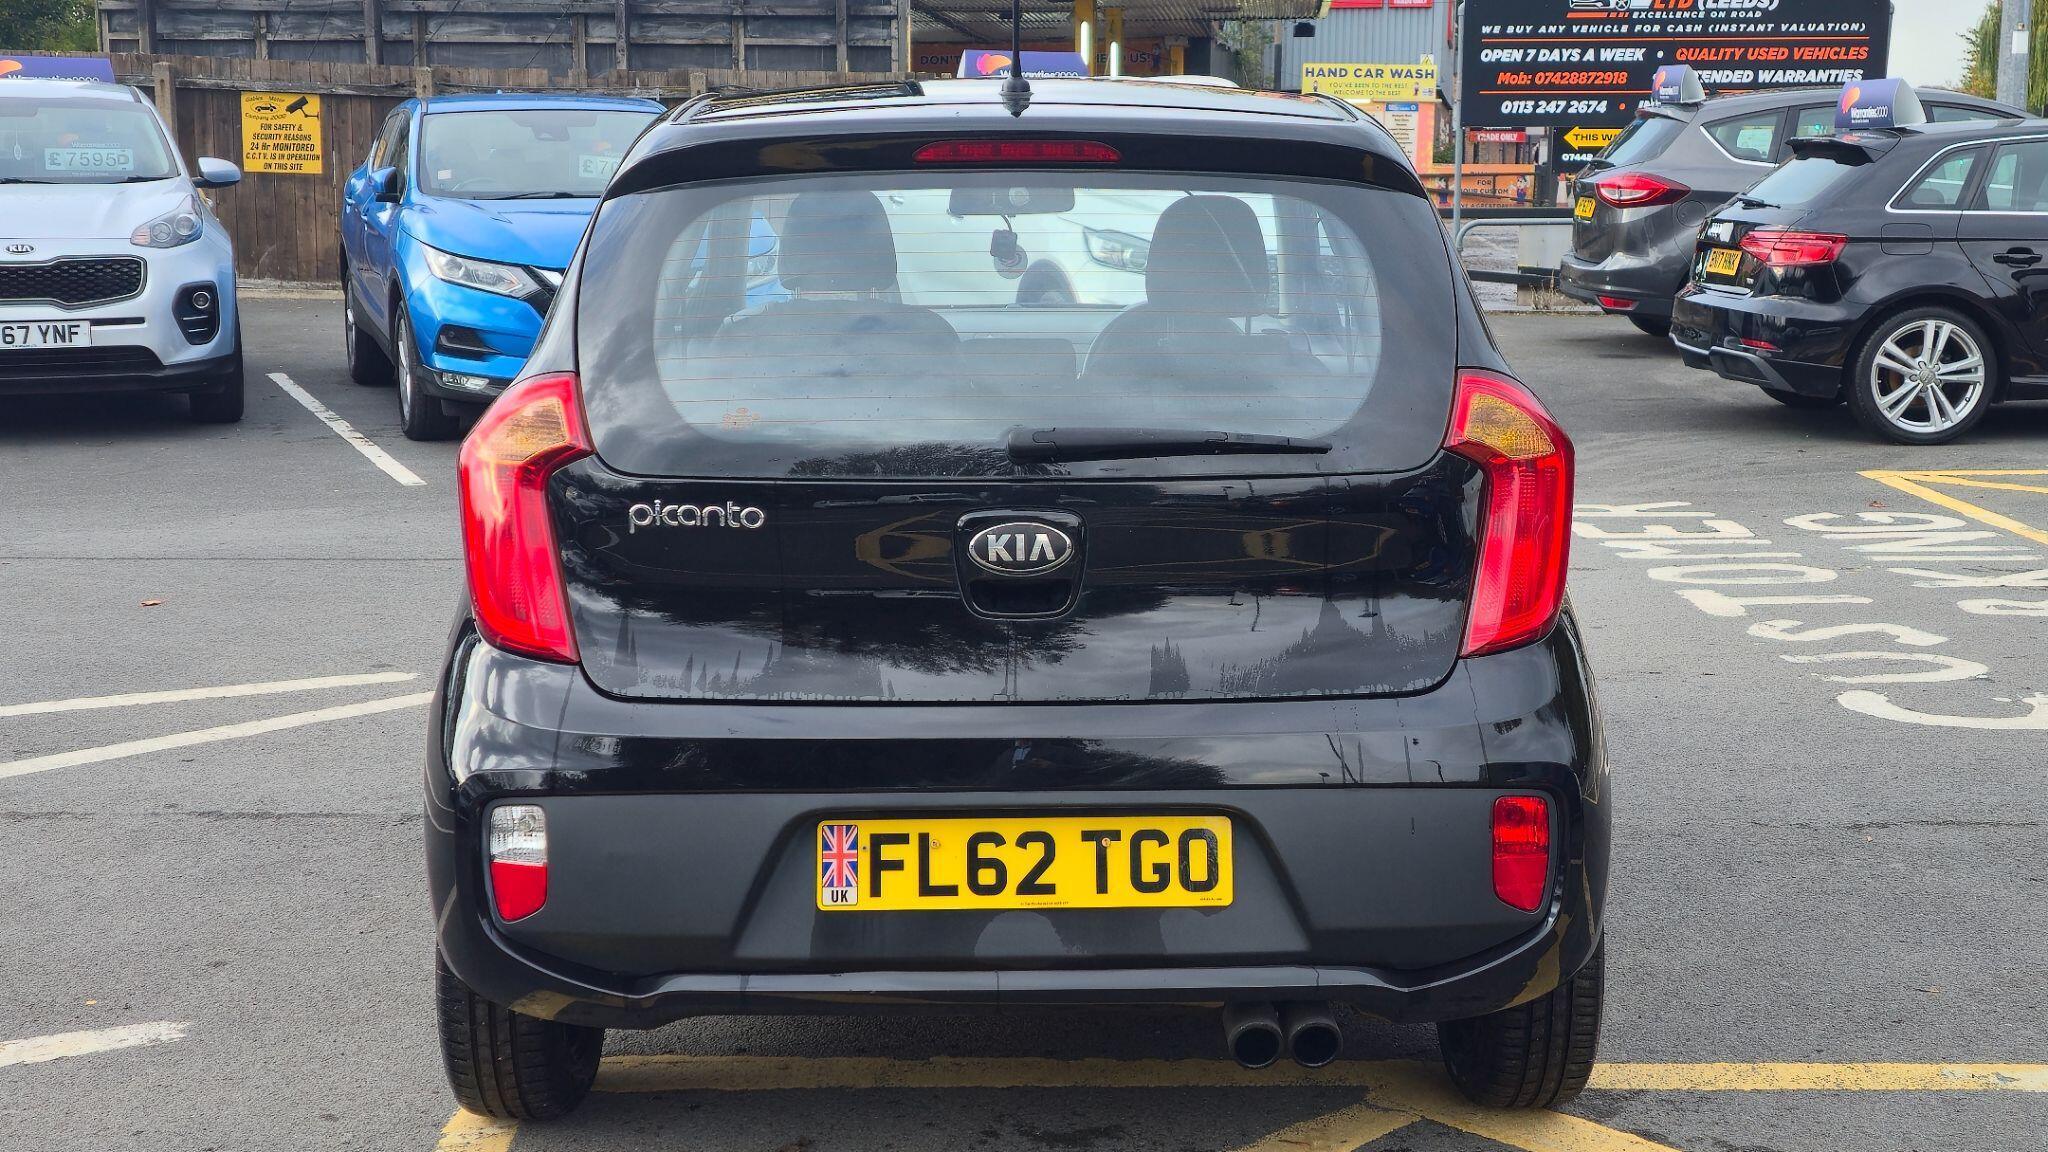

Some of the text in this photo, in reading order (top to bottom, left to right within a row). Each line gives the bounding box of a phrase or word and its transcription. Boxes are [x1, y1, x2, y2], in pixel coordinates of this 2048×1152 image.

[1632, 11, 1705, 19] EXCELLENCE
[1481, 23, 1867, 34] WE BUY ANY VEHICLE FOR CASH (INSTANT VALUATION)
[1480, 48, 1647, 63] OPEN 7 DAYS A WEEK
[1675, 46, 1869, 61] QUALITY USED VEHICLES
[1305, 67, 1435, 79] HAND CAR WASH
[1497, 71, 1627, 84] Mob: 07428872918
[1697, 69, 1864, 82] ENDED WARRANTIES
[1500, 100, 1608, 114] 0113 247 2674
[260, 123, 272, 131] FOR
[274, 123, 297, 131] SAFETY
[252, 133, 312, 142] SECURITY REASONS
[1573, 133, 1599, 141] THIS
[250, 142, 315, 152] 24 Hr MONITORED
[286, 153, 321, 161] OPERATION
[264, 162, 304, 171] ON THIS SITE
[1, 324, 81, 345] 67 YNF
[628, 500, 766, 534] picanto
[987, 534, 1056, 562] KIA
[1572, 501, 2048, 729] CUSTOMER
[869, 828, 1219, 898] FL62 TGO
[831, 889, 849, 904] UK
